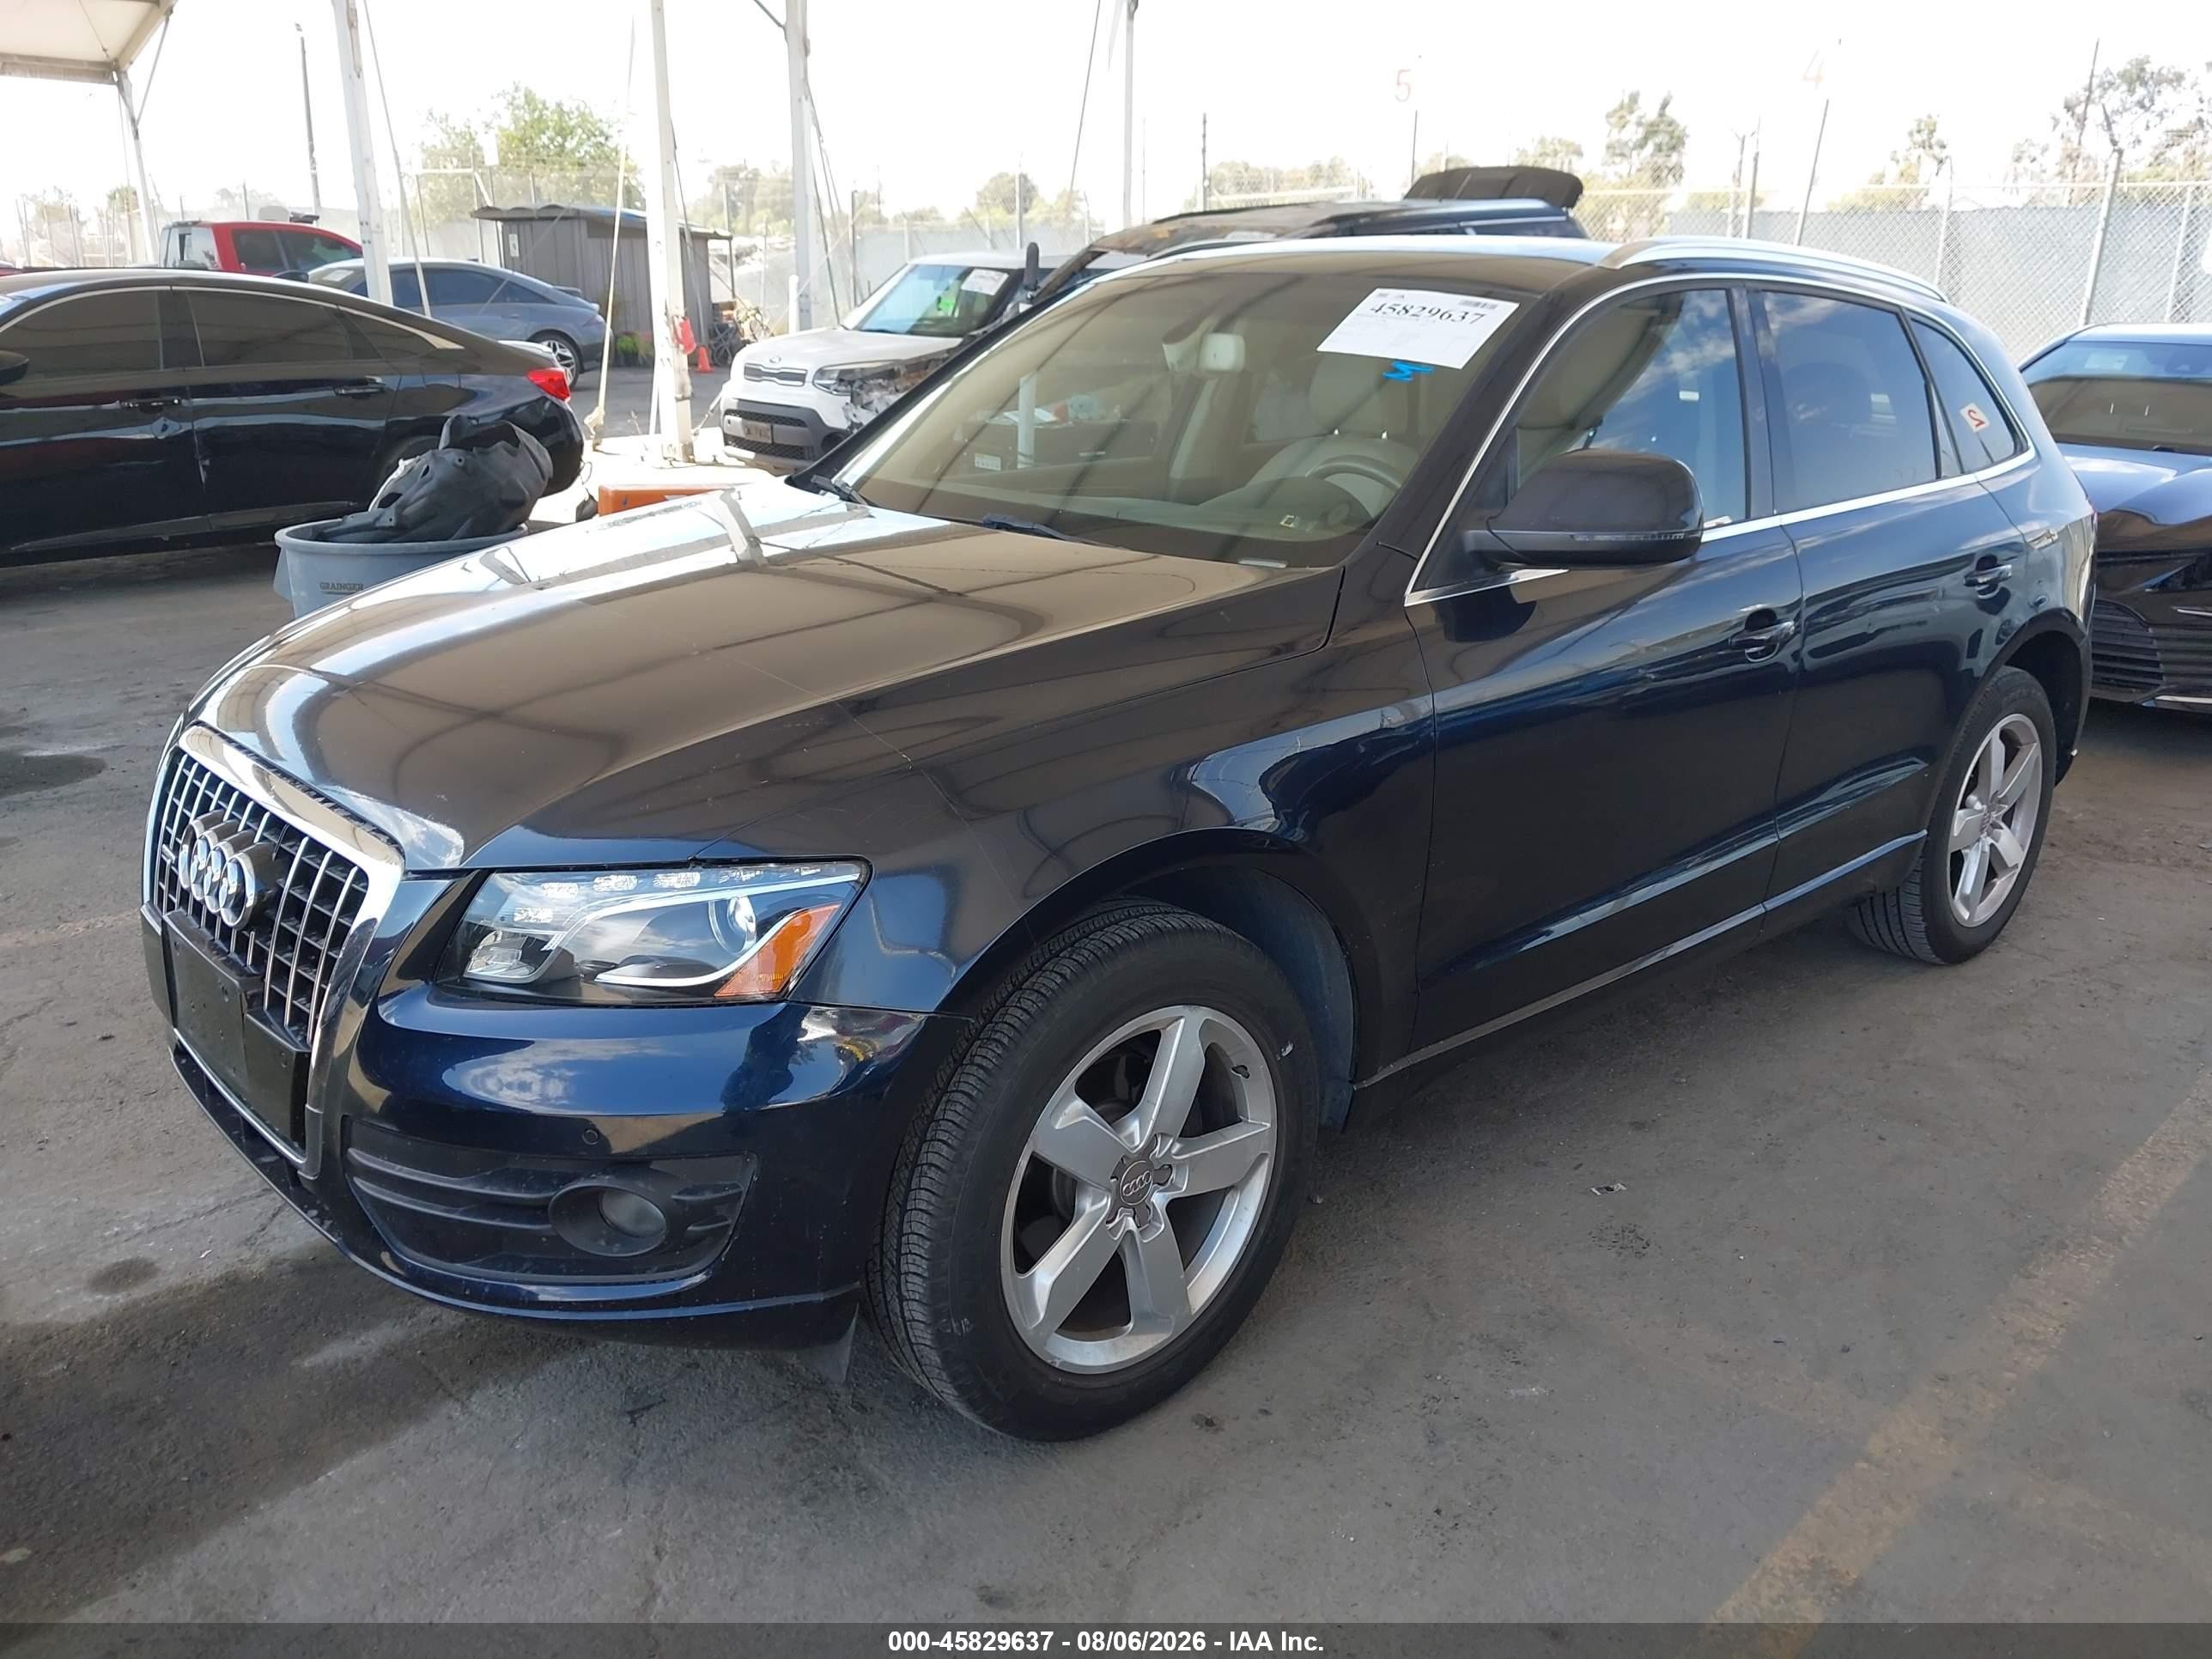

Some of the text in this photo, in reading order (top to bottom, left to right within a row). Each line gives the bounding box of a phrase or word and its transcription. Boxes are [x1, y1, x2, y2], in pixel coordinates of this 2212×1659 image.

[1394, 69, 1412, 103] 5
[1802, 49, 1825, 90] 4
[1370, 301, 1487, 325] 45829637
